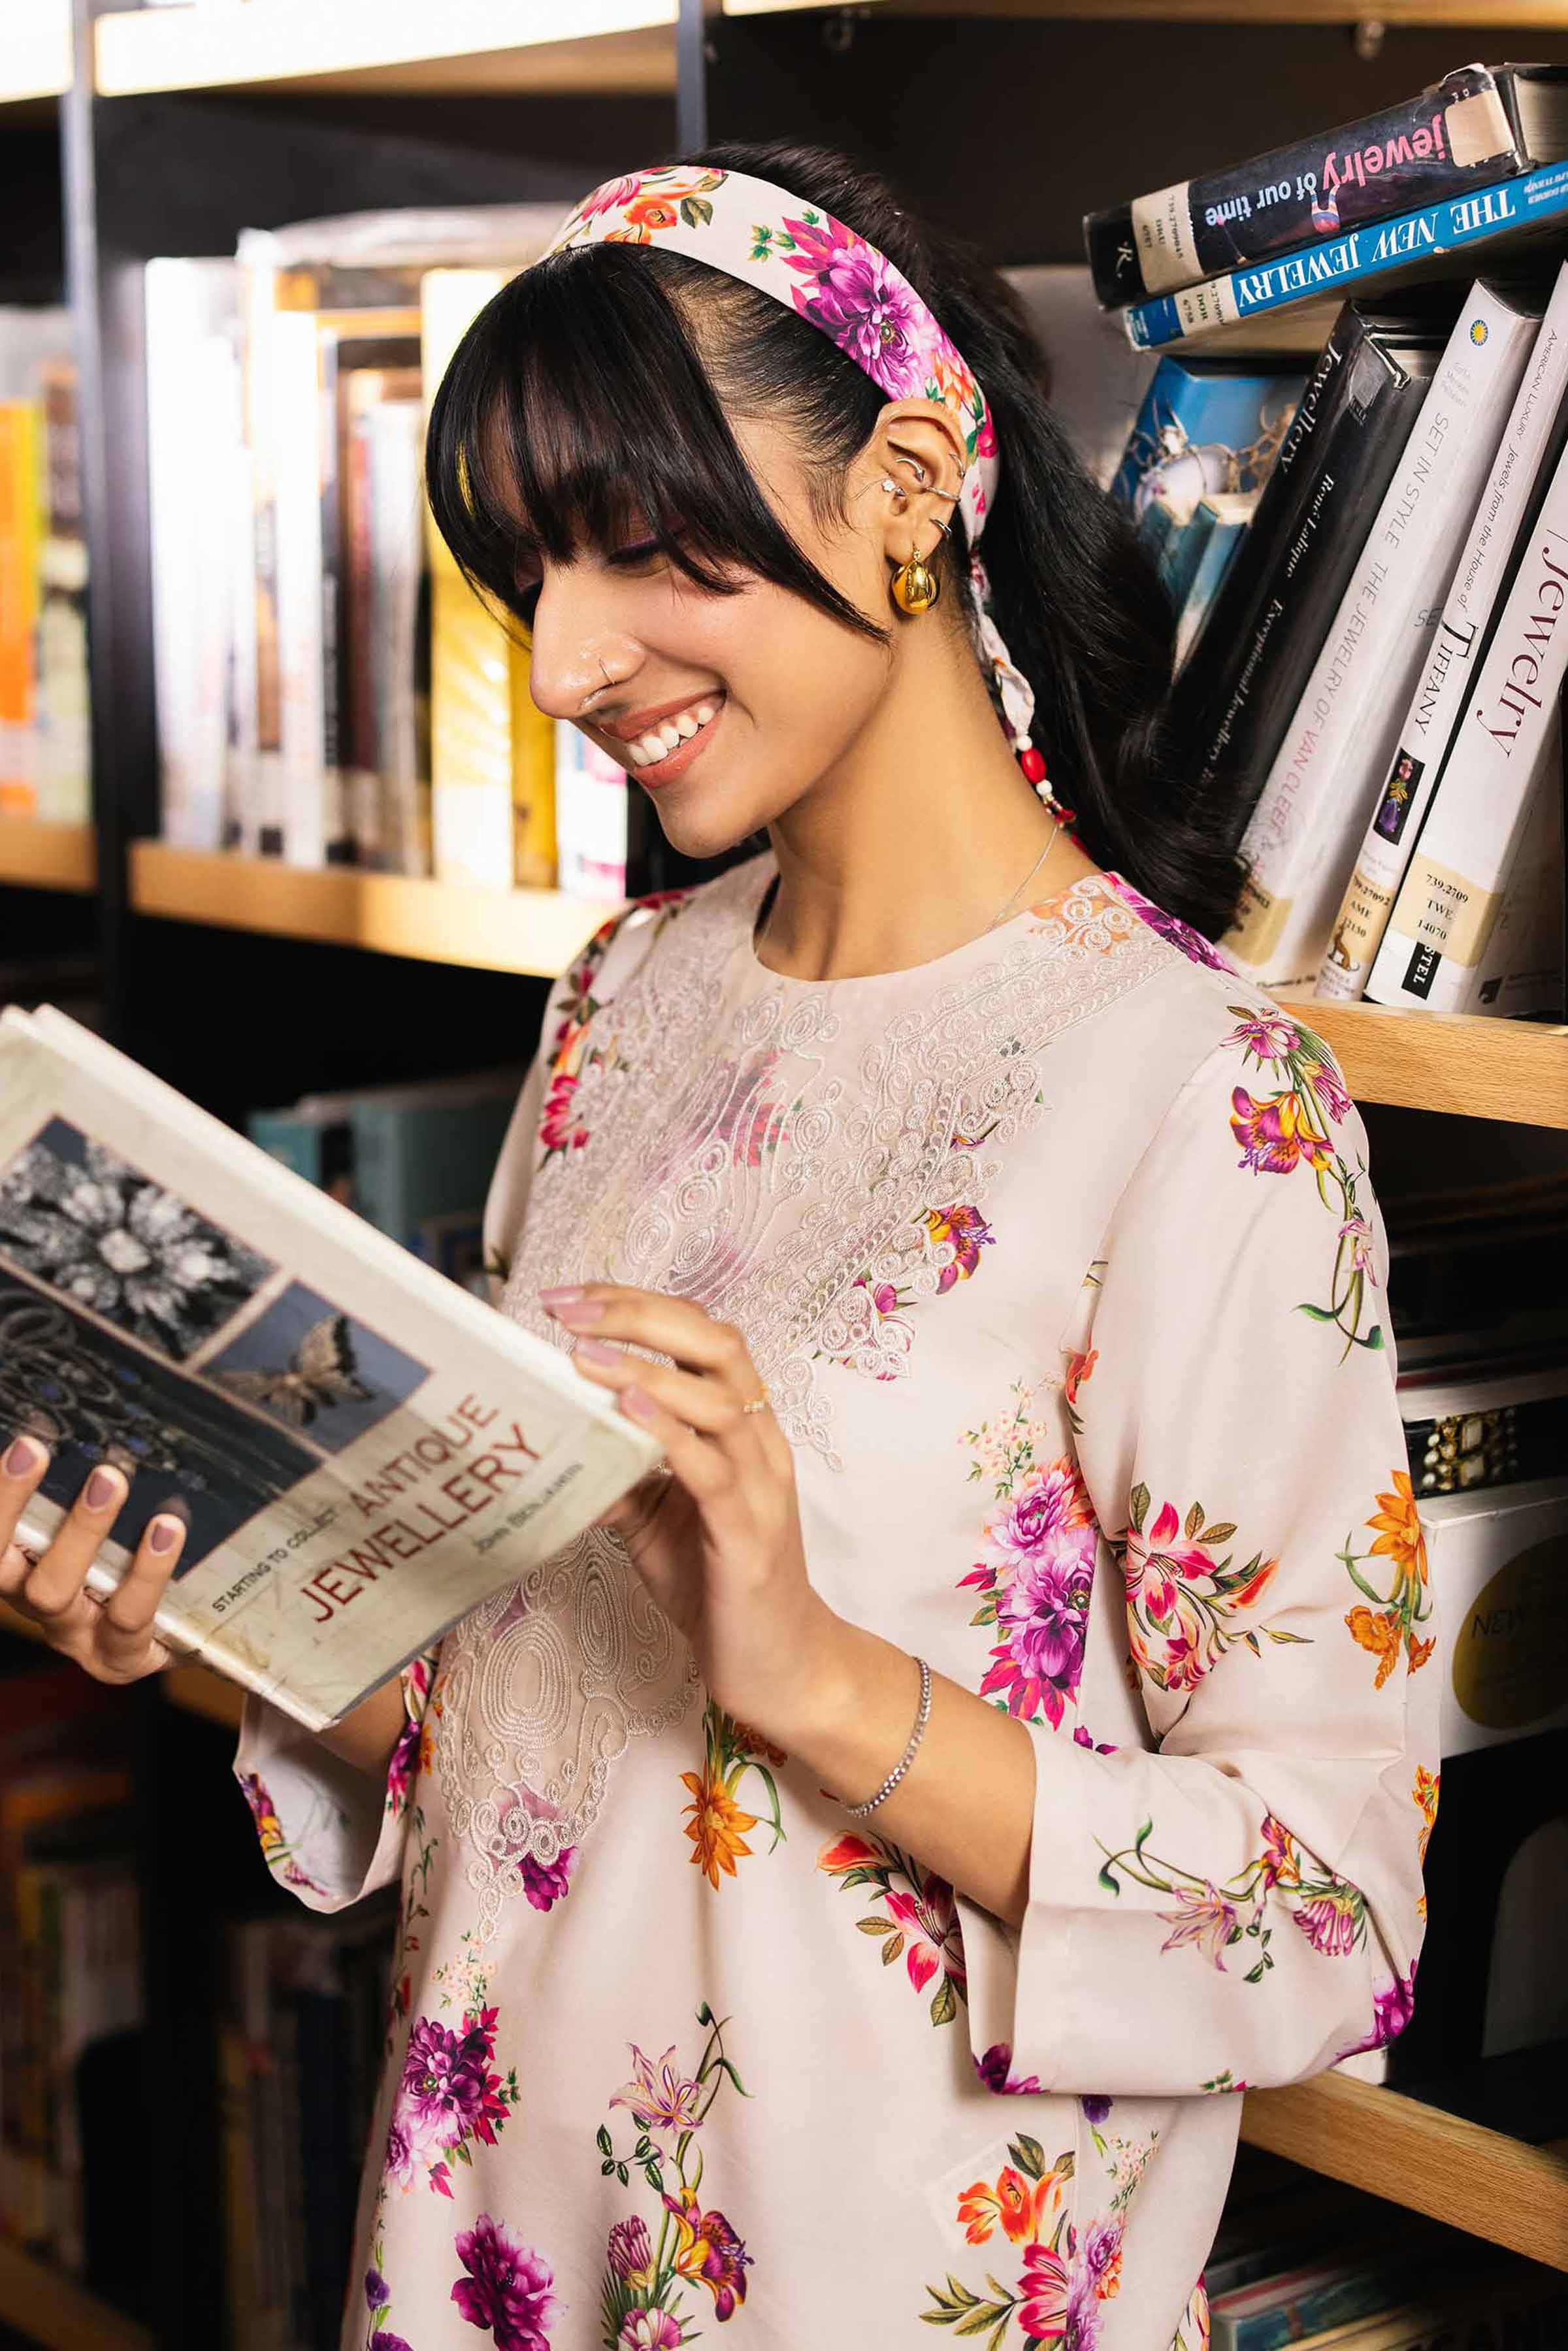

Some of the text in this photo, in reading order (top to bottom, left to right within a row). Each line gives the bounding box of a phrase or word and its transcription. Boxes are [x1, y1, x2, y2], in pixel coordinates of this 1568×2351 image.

[1205, 112, 1445, 226] jewelry of our time
[1239, 188, 1516, 308] THE NEW JEWELRY
[1281, 340, 1343, 473] Jewellery
[1425, 412, 1449, 456] SET
[1313, 472, 1335, 519] René
[1413, 456, 1432, 484] IN
[1286, 517, 1317, 578] Lalique
[1384, 483, 1420, 550] STYLE
[1414, 329, 1558, 736] AMERICAN LUXURY Jewels from the House of TIFFANY
[1361, 559, 1390, 606] THE
[1325, 602, 1368, 700] JEWELRY
[1476, 546, 1568, 759] Jewelry
[1312, 697, 1331, 732] OF
[1292, 729, 1320, 772] VAN
[1426, 874, 1469, 904] 739.2709
[1426, 898, 1456, 920] TWE
[1416, 919, 1448, 941] 14070
[350, 1393, 500, 1519] ANTIQUE
[300, 1421, 543, 1624] JEWELLERY
[212, 1562, 272, 1613] STARTING
[267, 1547, 289, 1564] TO
